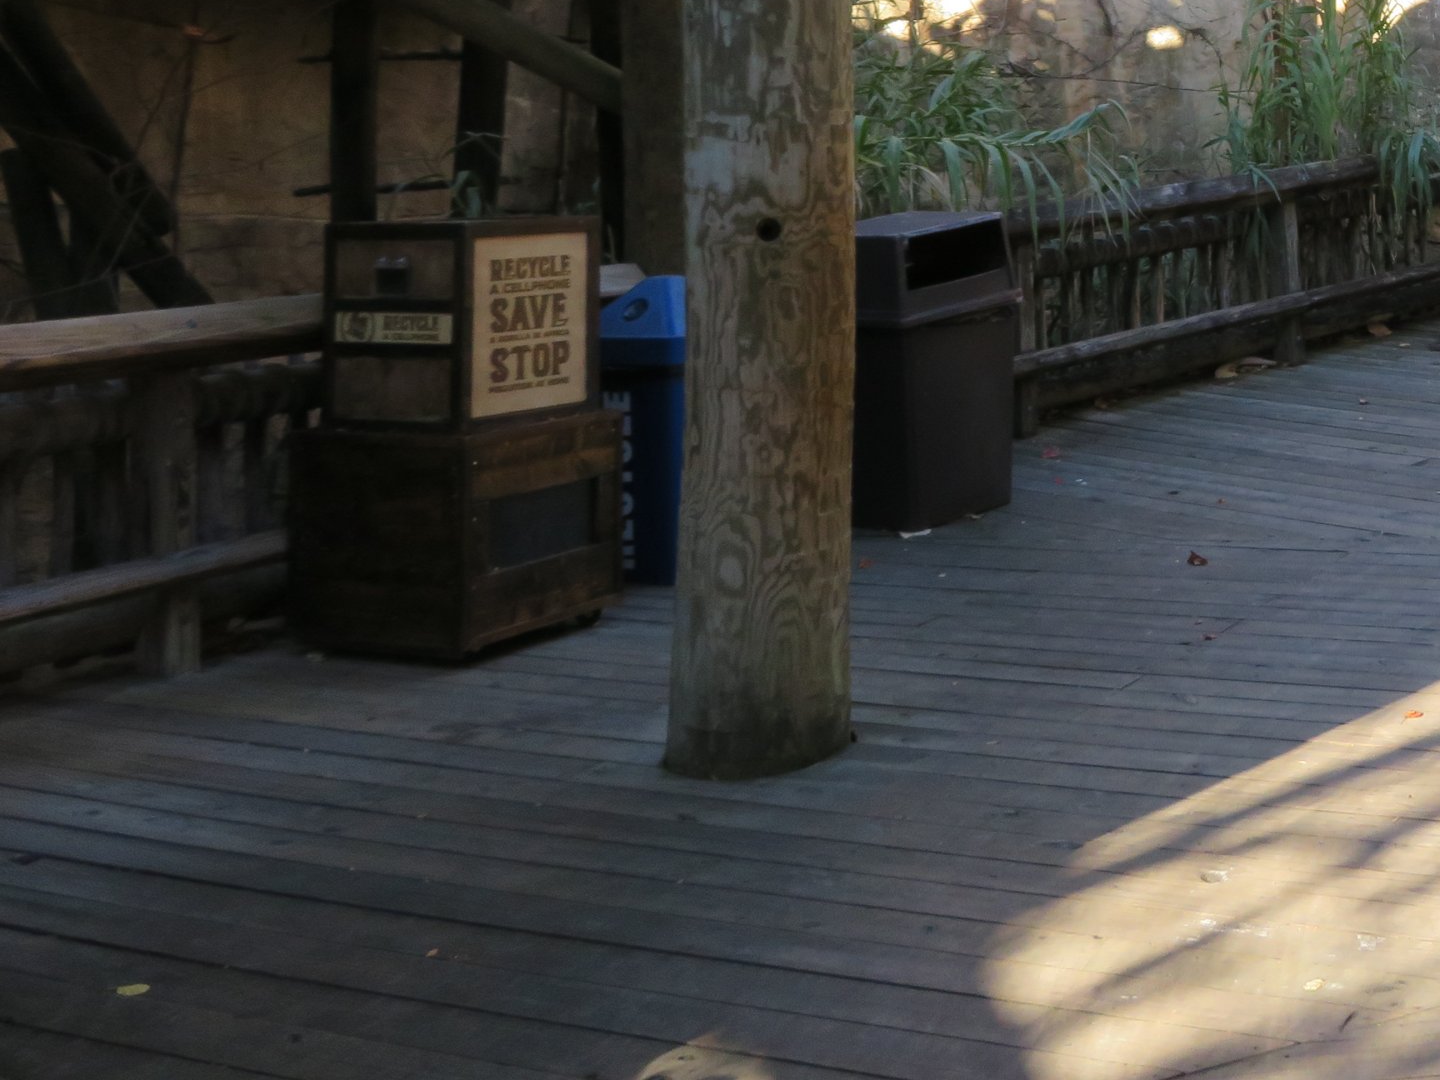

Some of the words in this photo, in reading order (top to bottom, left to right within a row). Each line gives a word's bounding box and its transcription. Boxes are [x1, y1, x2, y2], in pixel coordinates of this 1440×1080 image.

[490, 255, 571, 281] RECYCLE
[489, 284, 499, 295] A
[503, 279, 571, 293] CELLPHONE
[383, 315, 440, 331] RECYCLE
[490, 293, 569, 333] SAVE
[490, 340, 570, 383] STOP
